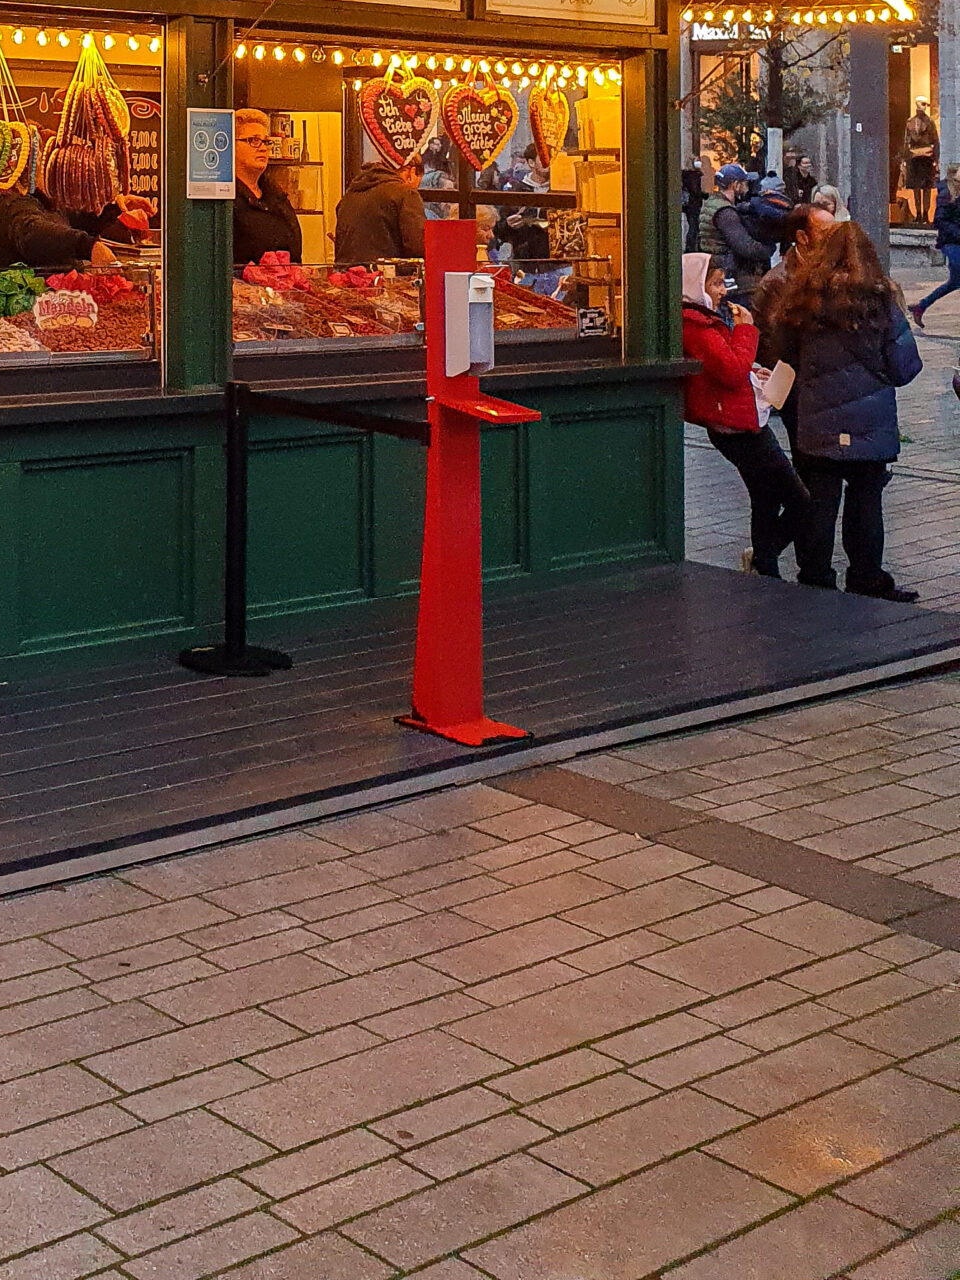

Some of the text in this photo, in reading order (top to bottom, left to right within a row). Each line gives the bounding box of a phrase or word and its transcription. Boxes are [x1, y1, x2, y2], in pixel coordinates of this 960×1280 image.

[378, 94, 400, 117] Ich
[457, 104, 492, 125] Meine
[131, 131, 157, 149] 7,00 €
[131, 153, 158, 171] 7,00 €
[131, 175, 158, 194] 9,00 €
[38, 297, 96, 318] Mandeln
